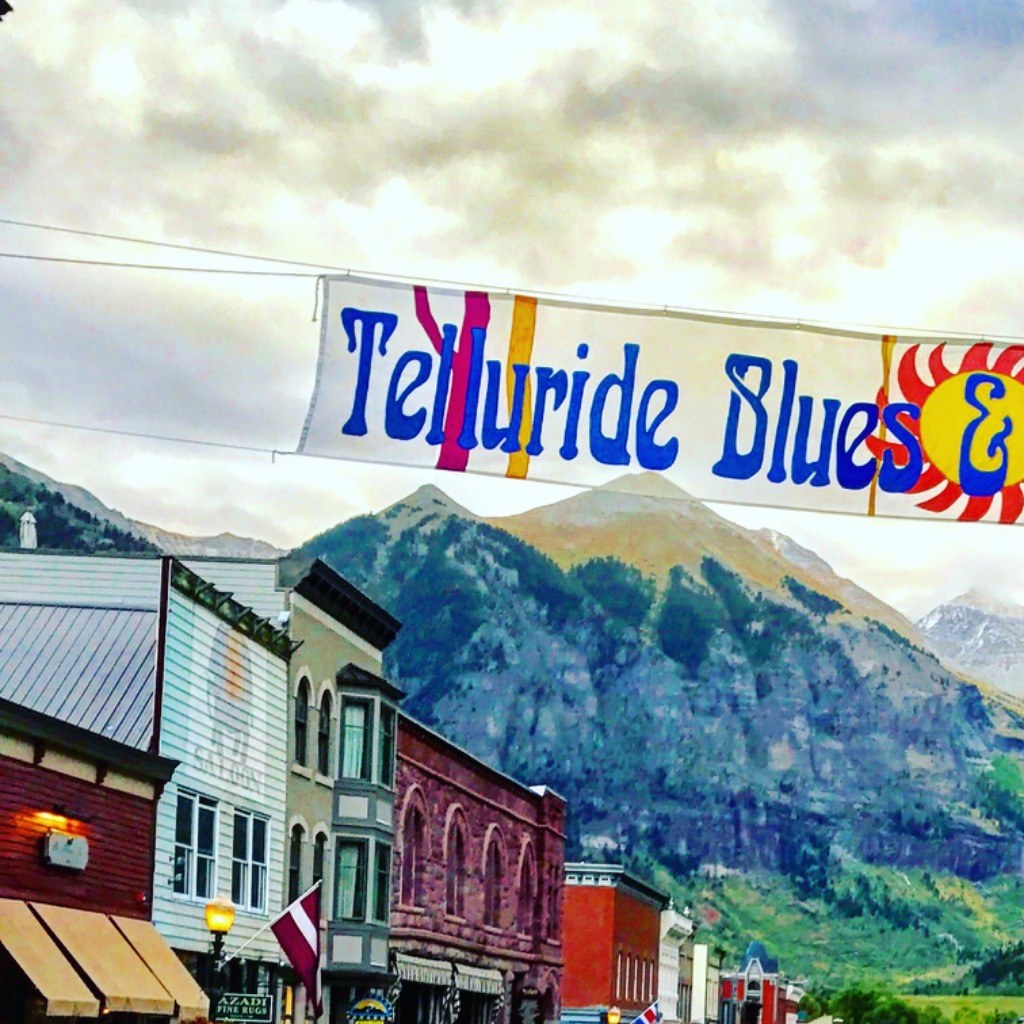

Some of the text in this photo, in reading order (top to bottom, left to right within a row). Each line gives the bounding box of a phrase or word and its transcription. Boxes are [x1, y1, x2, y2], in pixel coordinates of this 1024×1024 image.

[341, 307, 679, 470] Telluride
[711, 353, 923, 493] Blues
[959, 373, 1013, 497] &
[217, 996, 268, 1006] AZADI
[217, 1005, 268, 1015] FINE RUGS
